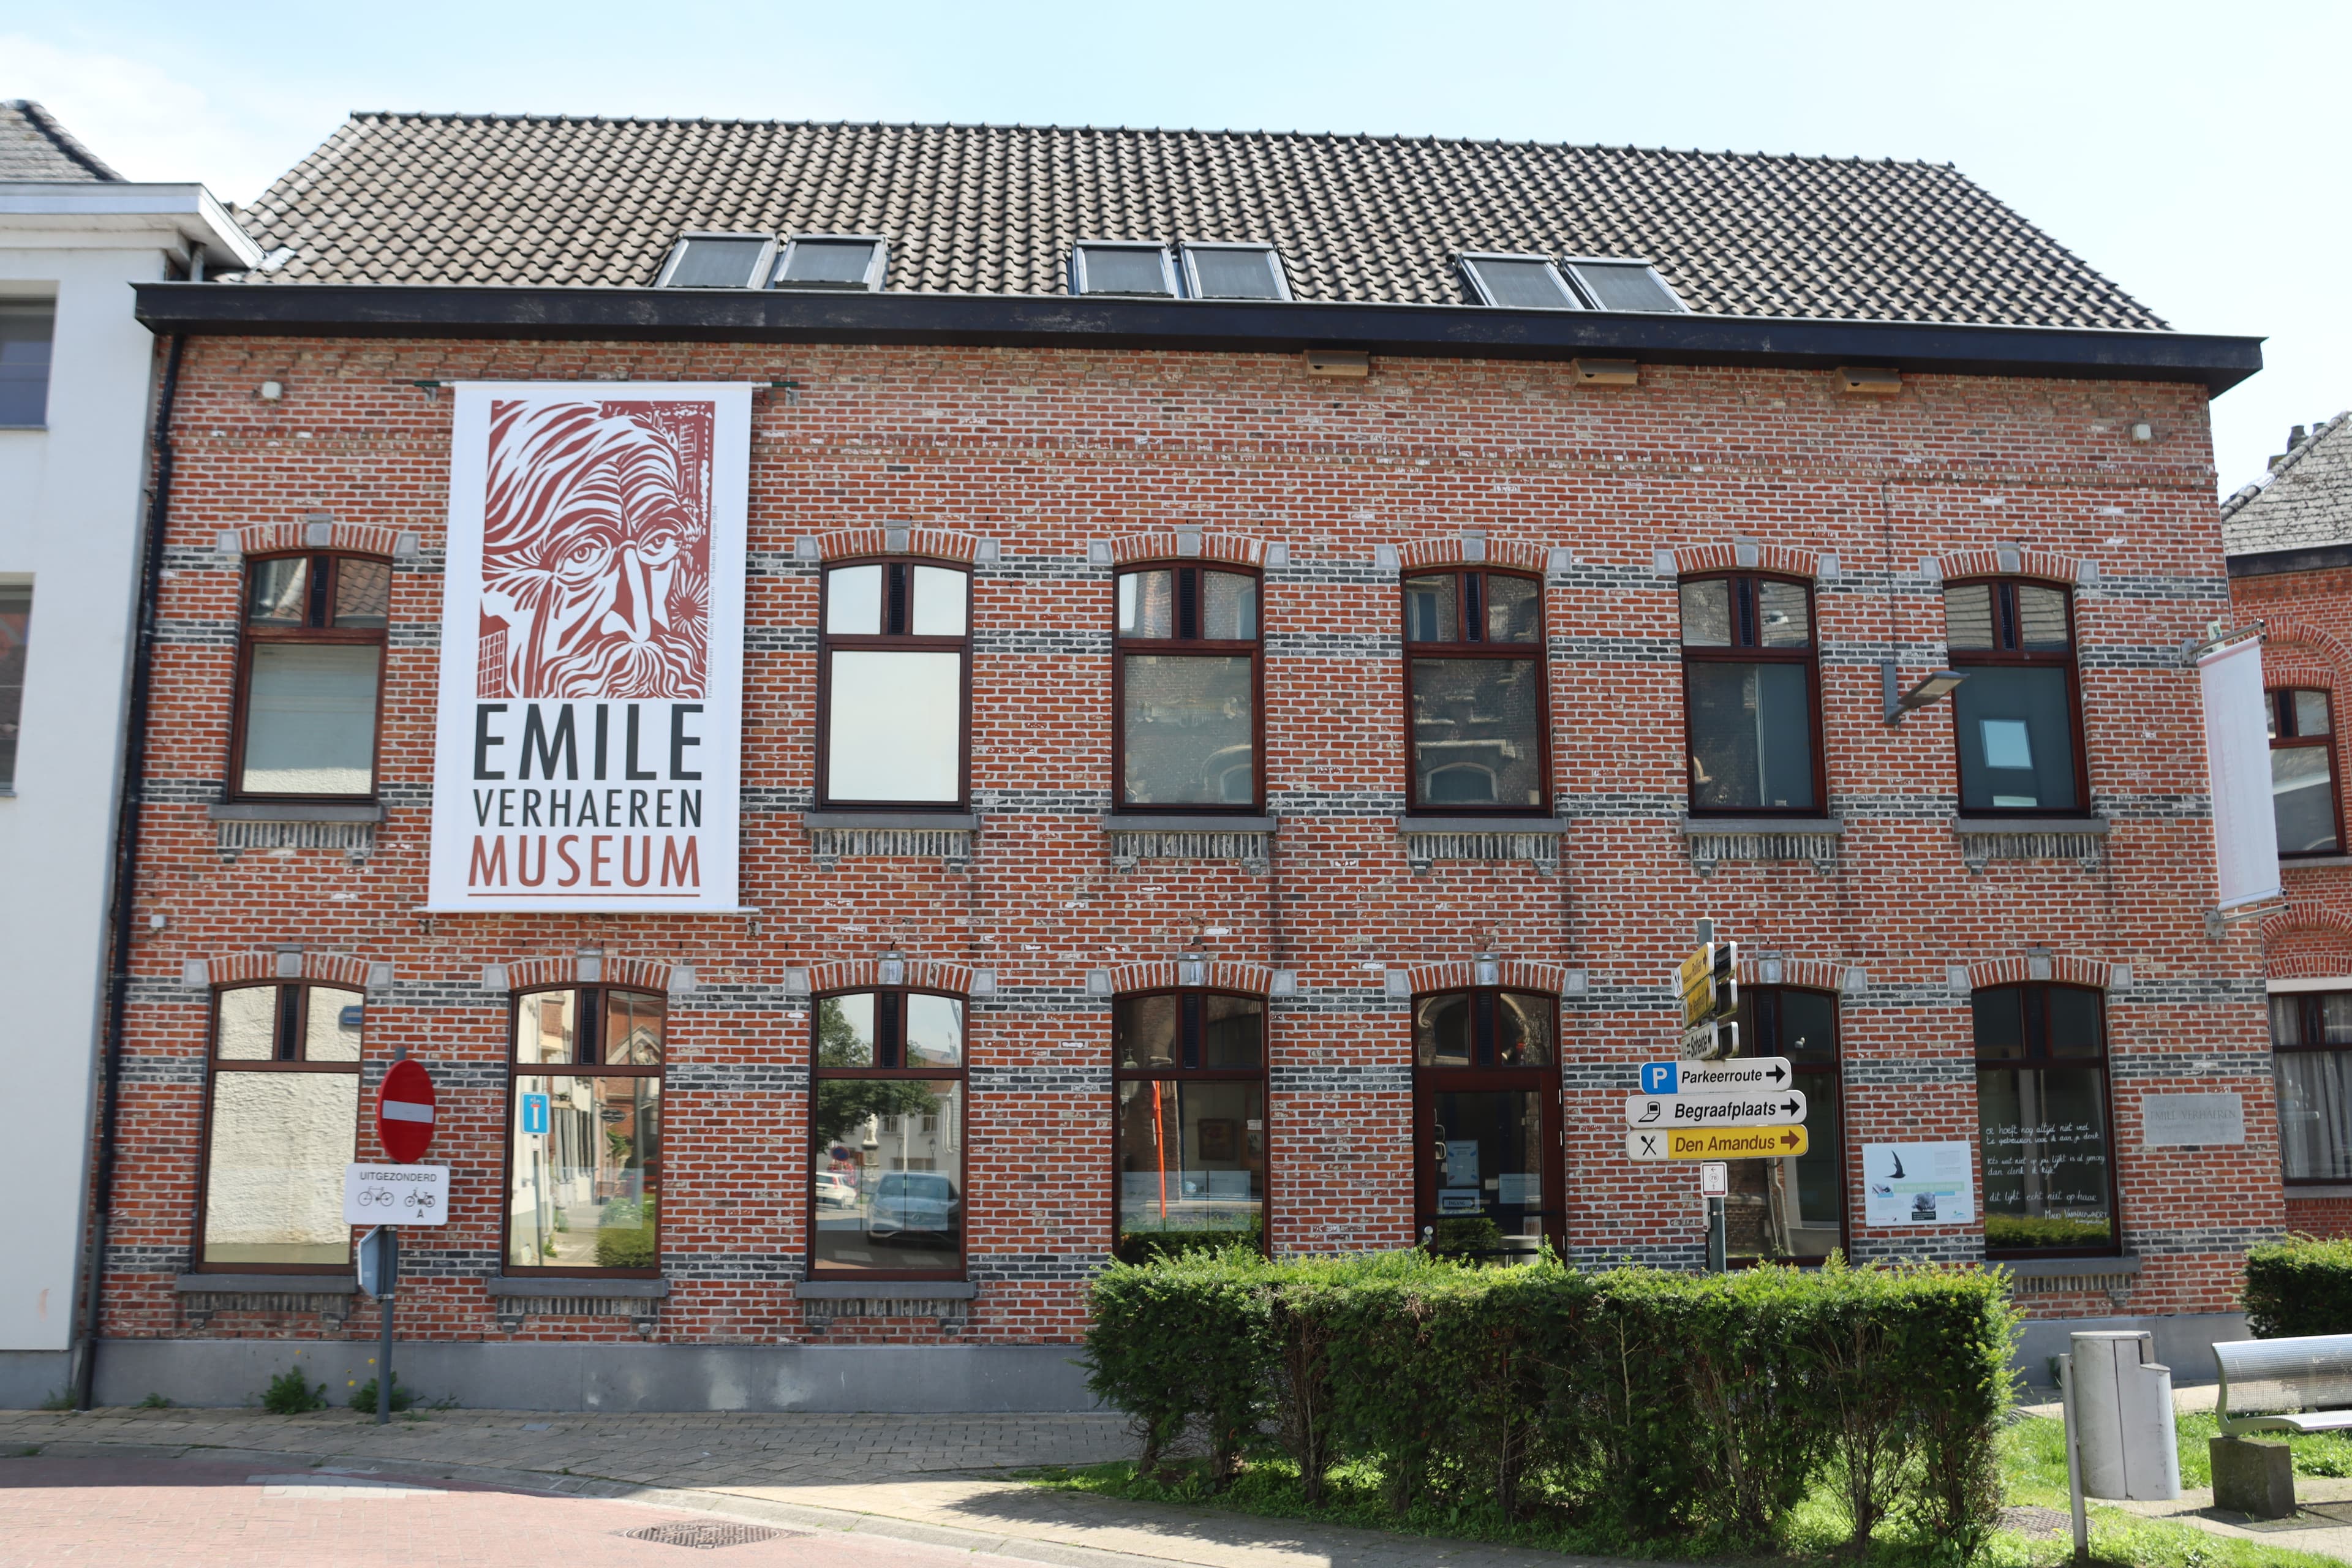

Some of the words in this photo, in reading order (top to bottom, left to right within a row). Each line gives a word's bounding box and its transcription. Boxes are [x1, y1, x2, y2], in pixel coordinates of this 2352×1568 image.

[473, 703, 704, 780] EMILE
[473, 788, 702, 827] VERHAEREN
[468, 834, 701, 888] MUSEUM
[1691, 1030, 1707, 1058] Schelde
[1653, 1068, 1667, 1088] P
[1681, 1069, 1762, 1084] Parkeerroute
[1675, 1102, 1776, 1121] Begraafplaats
[1999, 1122, 2018, 1137] hoeft
[2021, 1127, 2034, 1137] nog
[2037, 1122, 2056, 1135] altijd
[2060, 1122, 2072, 1132] niet
[1675, 1137, 1703, 1152] Den
[1708, 1134, 1775, 1152] Amandus
[1986, 1136, 1996, 1145] te
[2015, 1156, 2027, 1164] niet
[2052, 1154, 2067, 1167] lijkt
[2077, 1153, 2084, 1162] al
[360, 1172, 437, 1182] UITGEZONDERD
[1988, 1166, 2003, 1175] dan
[2007, 1166, 2024, 1175] denk
[1989, 1191, 2001, 1202] dit
[2026, 1190, 2043, 1200] echt
[2047, 1191, 2063, 1200] niet
[2067, 1194, 2075, 1204] op
[417, 1208, 424, 1218] A
